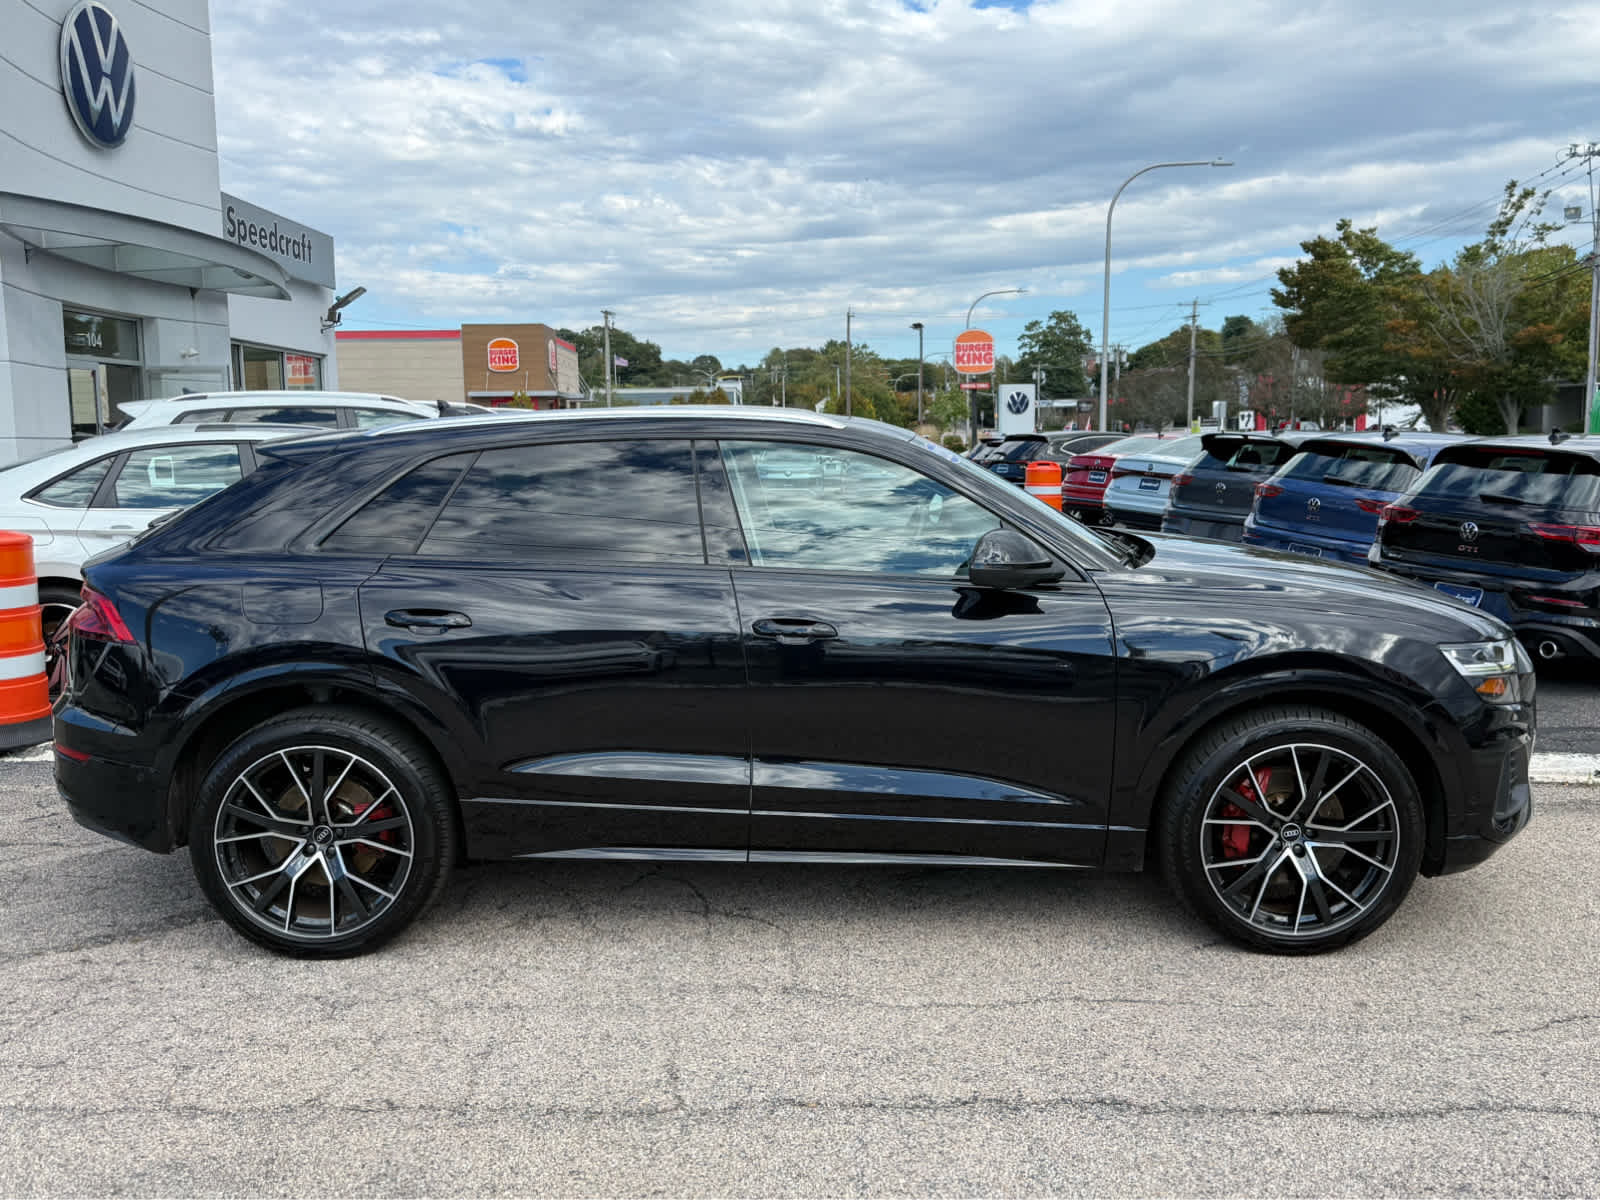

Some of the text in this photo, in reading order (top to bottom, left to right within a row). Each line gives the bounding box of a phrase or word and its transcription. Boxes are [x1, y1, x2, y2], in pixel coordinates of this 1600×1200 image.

[226, 206, 312, 264] Speedcraft
[86, 331, 103, 348] 104
[956, 344, 993, 352] BURGER
[489, 355, 517, 364] KING
[956, 352, 993, 365] KING
[1458, 544, 1479, 553] GTI
